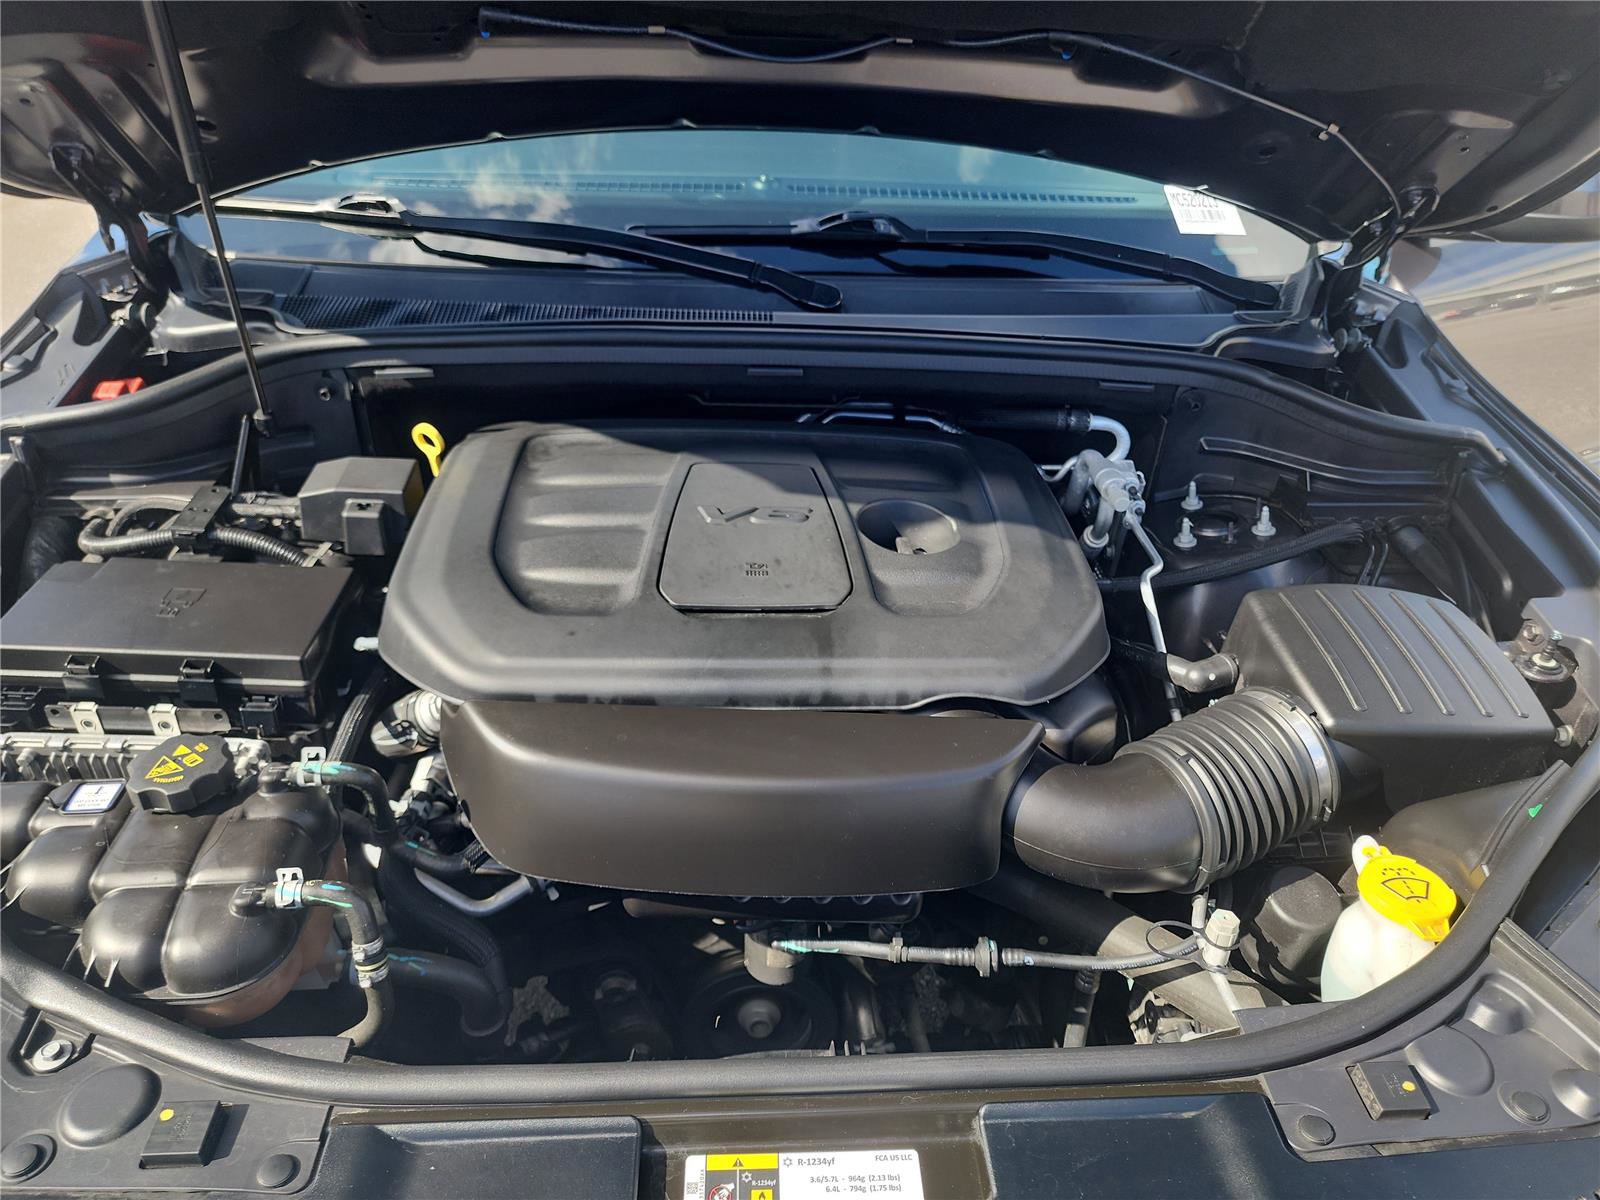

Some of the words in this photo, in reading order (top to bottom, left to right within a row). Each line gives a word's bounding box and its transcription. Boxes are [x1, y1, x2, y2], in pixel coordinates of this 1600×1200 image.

[797, 1157, 835, 1167] R-1234yf
[809, 1175, 839, 1183] 3.6/5.7L
[848, 1175, 866, 1183] 964g
[868, 1174, 886, 1182] (2.13
[887, 1174, 901, 1182] lbs)
[849, 1185, 867, 1193] 794g
[869, 1184, 887, 1192] (1.75
[888, 1183, 902, 1192] lbs)
